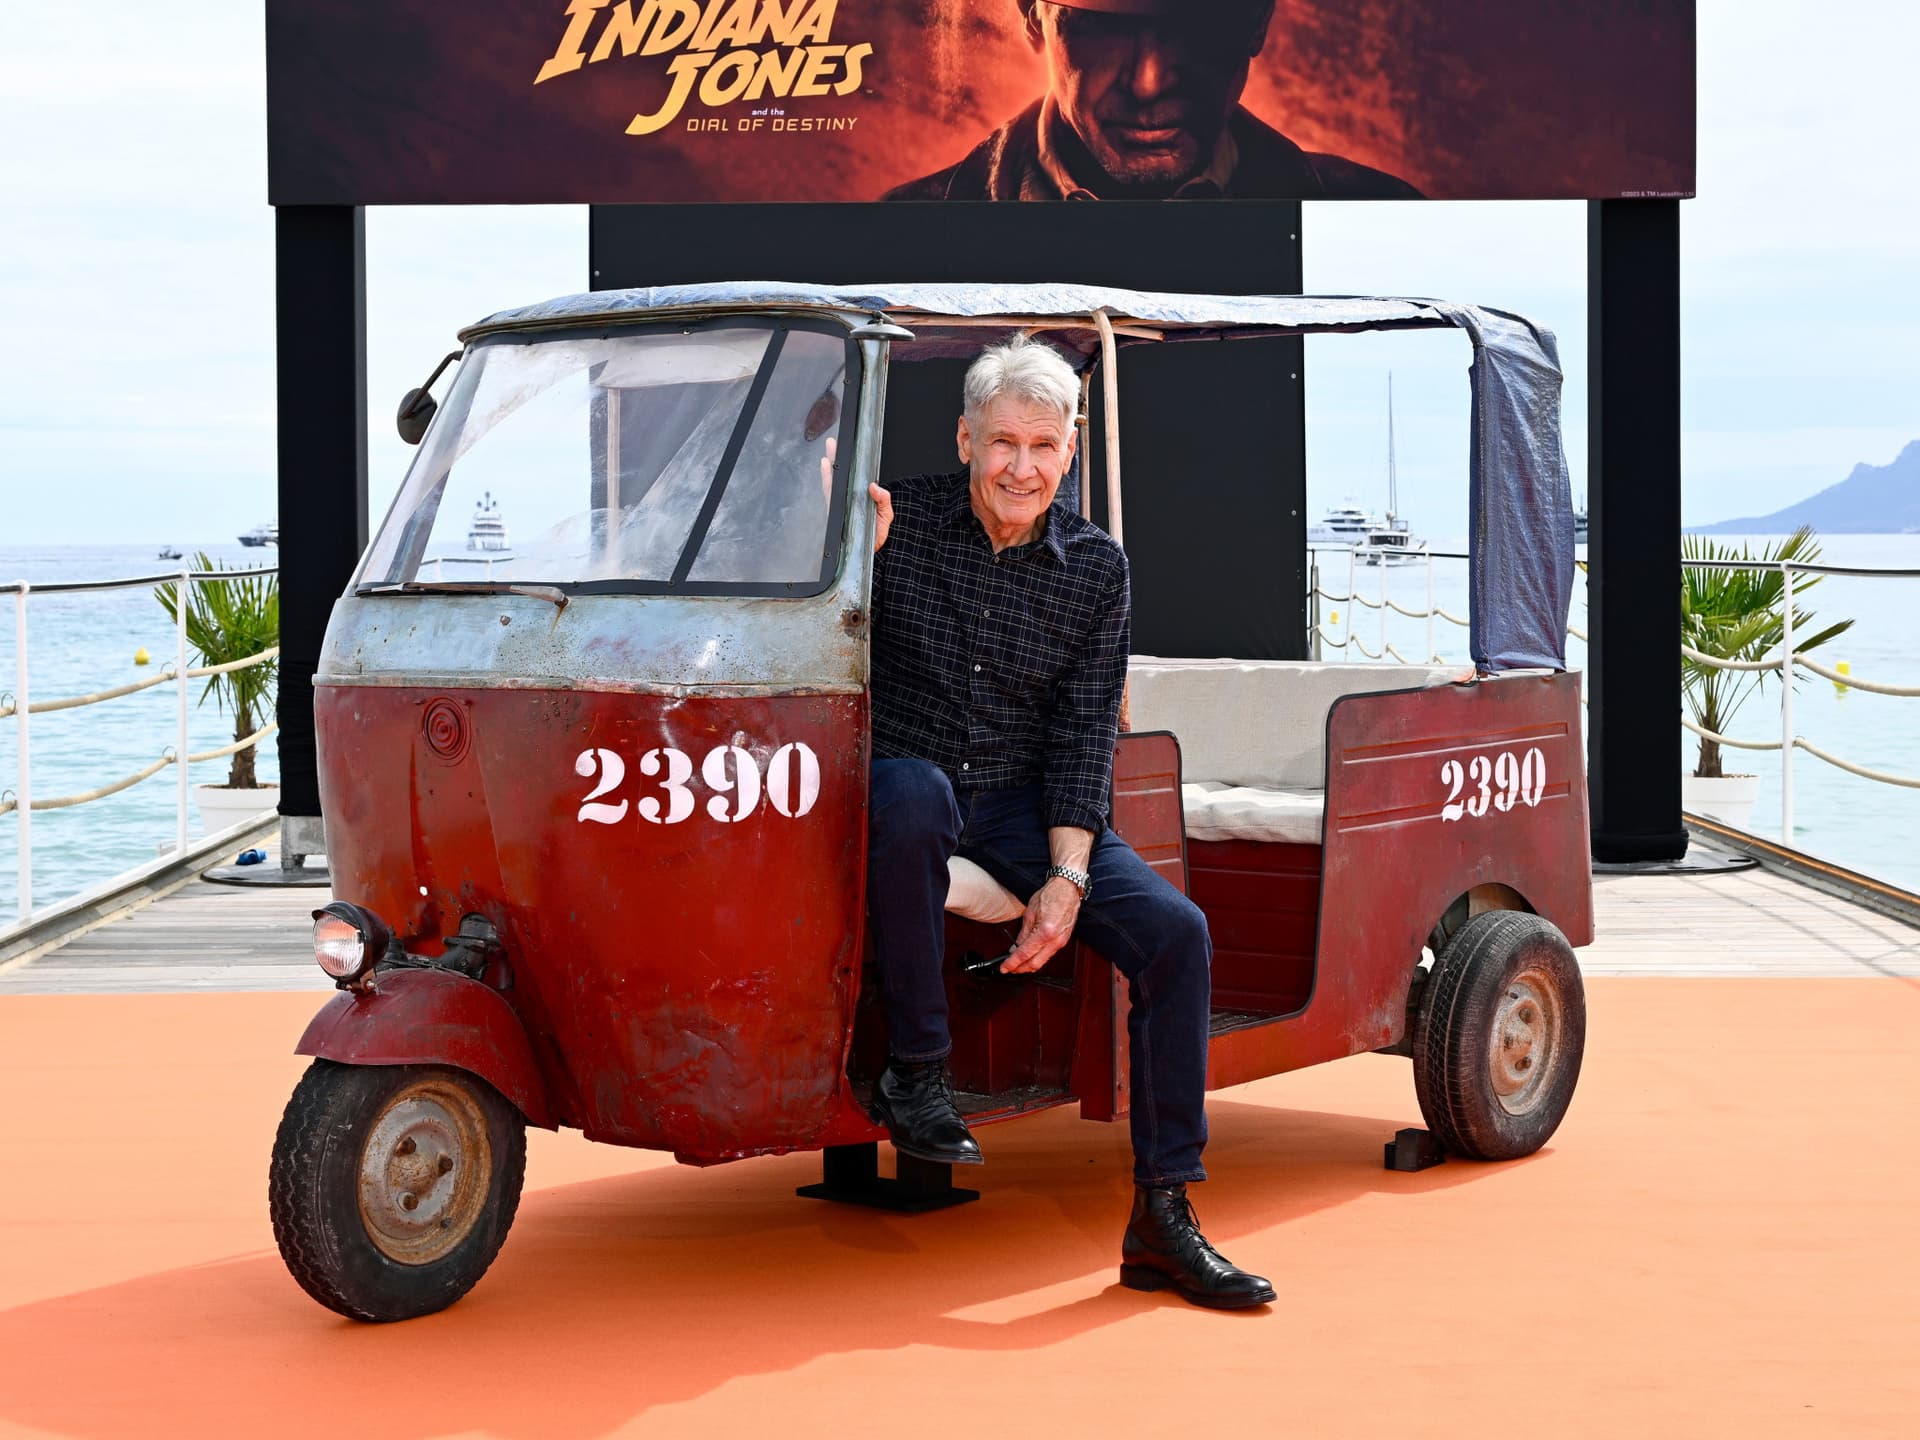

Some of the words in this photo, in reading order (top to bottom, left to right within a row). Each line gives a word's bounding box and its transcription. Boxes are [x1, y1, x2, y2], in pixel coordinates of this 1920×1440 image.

[534, 0, 838, 85] INDIANA
[624, 43, 873, 136] JONES
[686, 118, 729, 132] DIAL
[738, 118, 765, 132] OF
[772, 117, 858, 132] DESTINY
[752, 107, 768, 116] and
[771, 107, 785, 116] the
[575, 742, 820, 825] 2390
[1441, 747, 1547, 823] 2390
